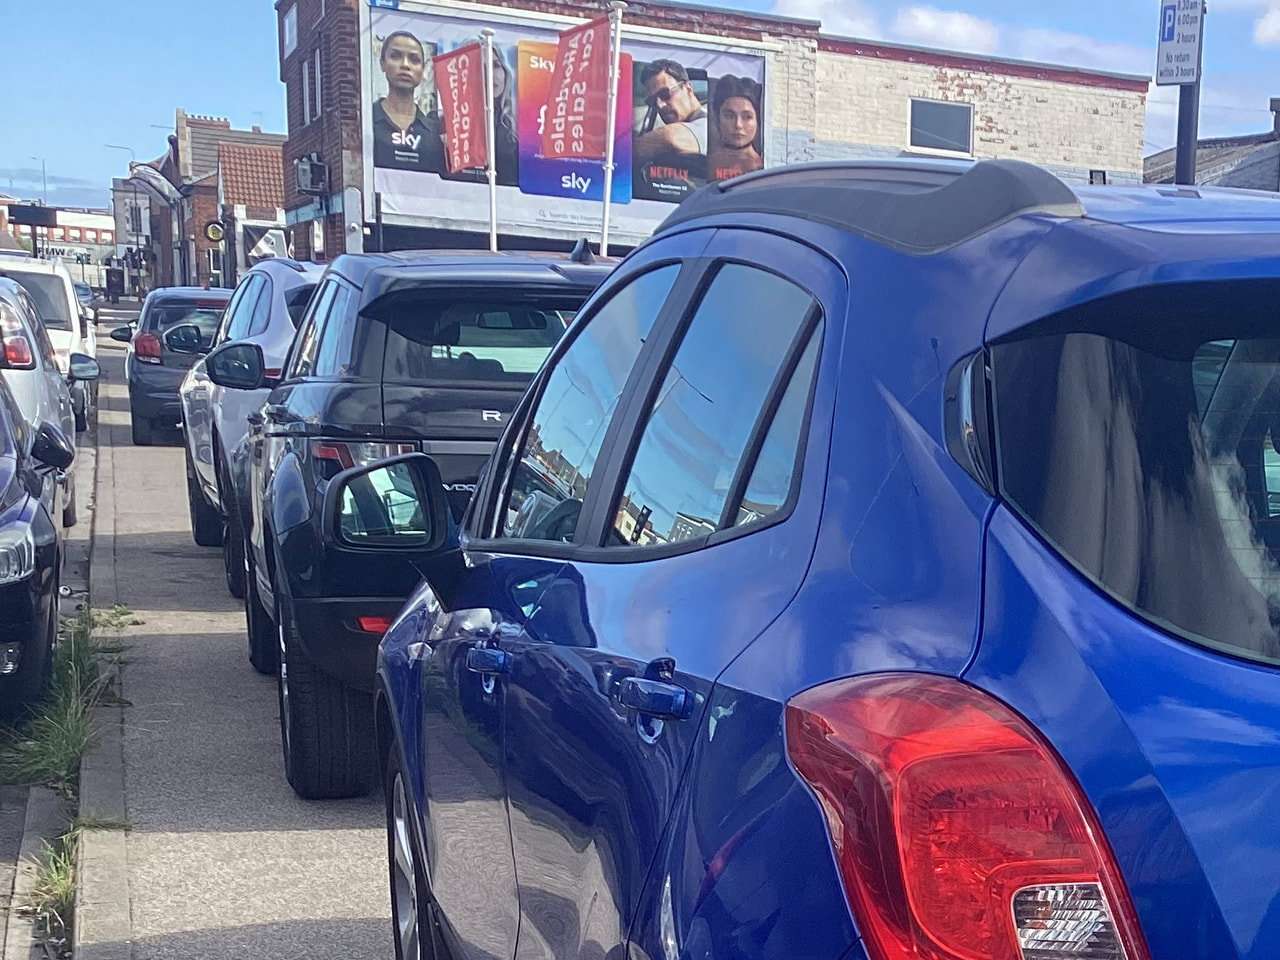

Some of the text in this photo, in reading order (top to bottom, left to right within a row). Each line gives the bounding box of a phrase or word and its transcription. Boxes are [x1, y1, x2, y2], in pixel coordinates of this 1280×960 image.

[391, 129, 421, 150] sky
[561, 172, 592, 193] sky
[650, 166, 689, 179] NETFLIX
